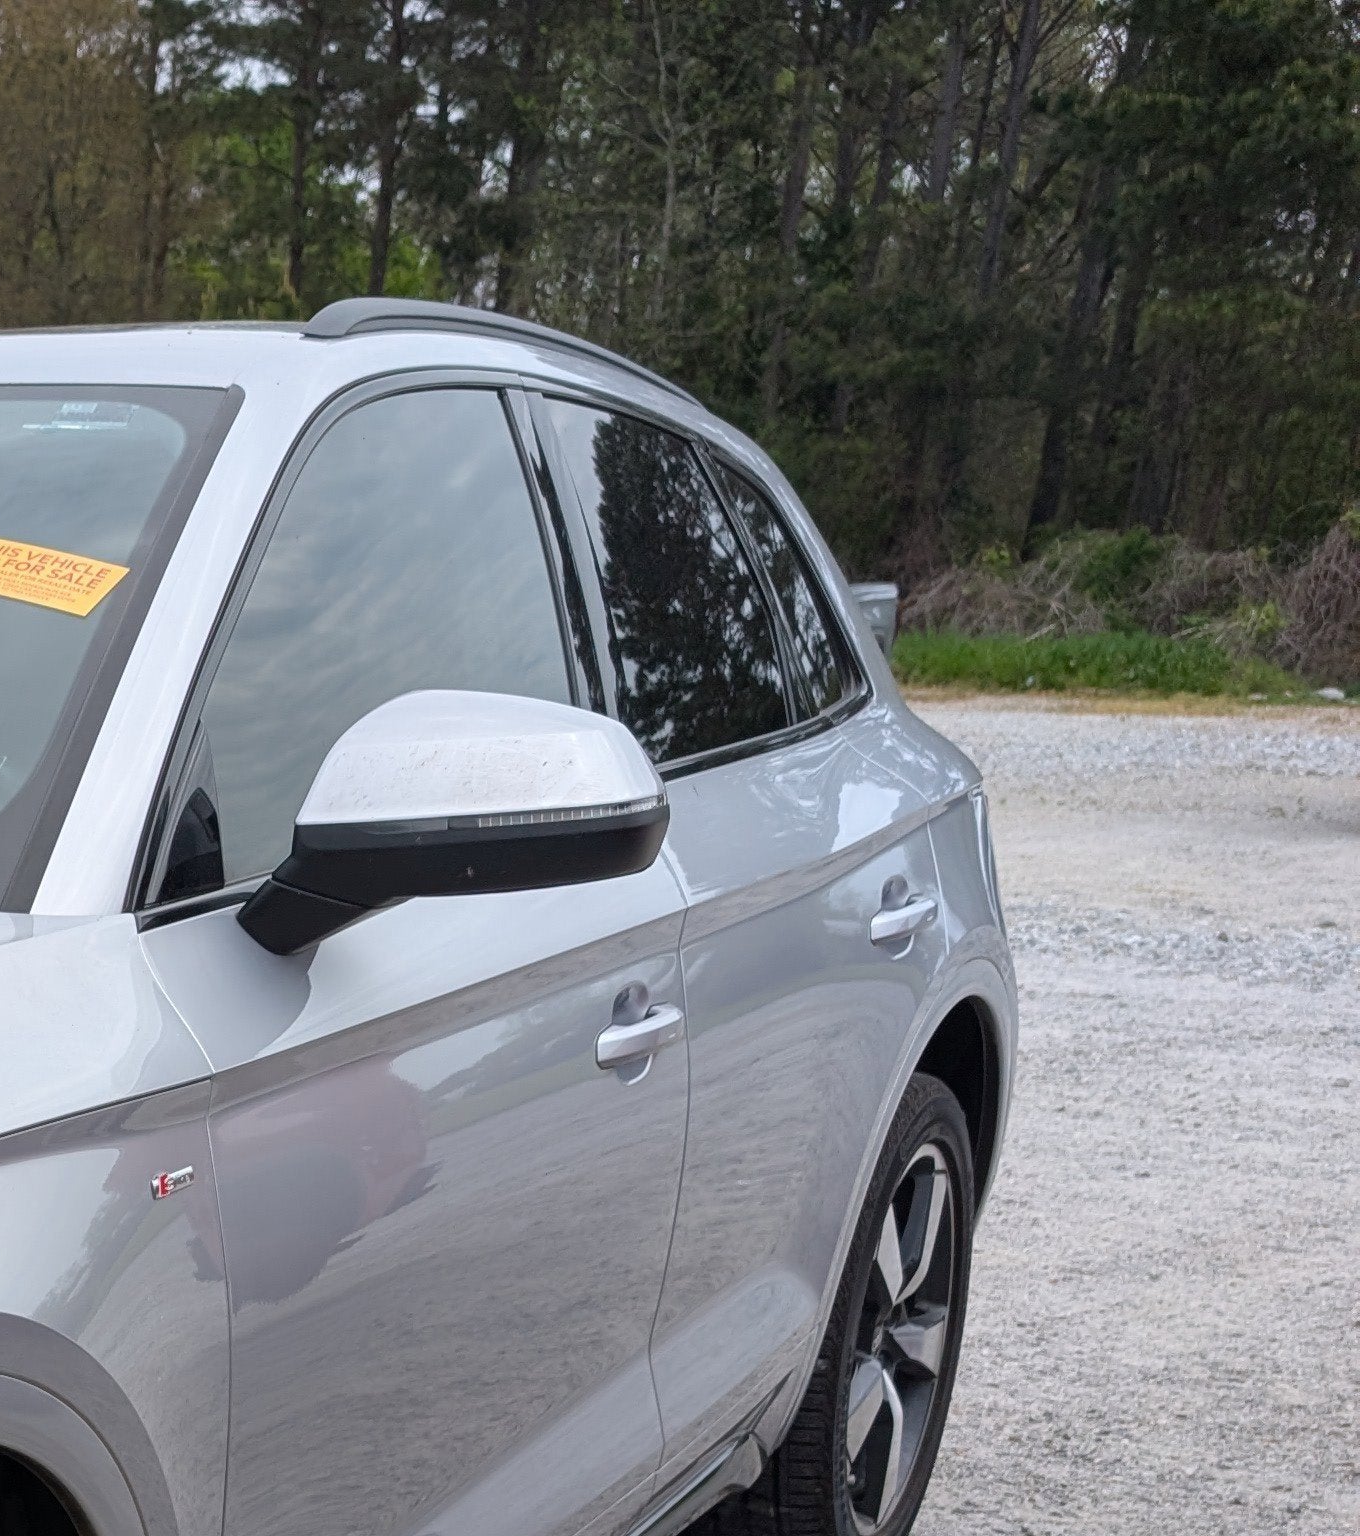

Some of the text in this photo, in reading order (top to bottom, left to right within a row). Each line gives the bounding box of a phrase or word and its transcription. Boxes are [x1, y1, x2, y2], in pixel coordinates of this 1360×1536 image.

[3, 558, 45, 575] FOR
[47, 569, 102, 589] SALE
[27, 550, 111, 579] VEHICLE
